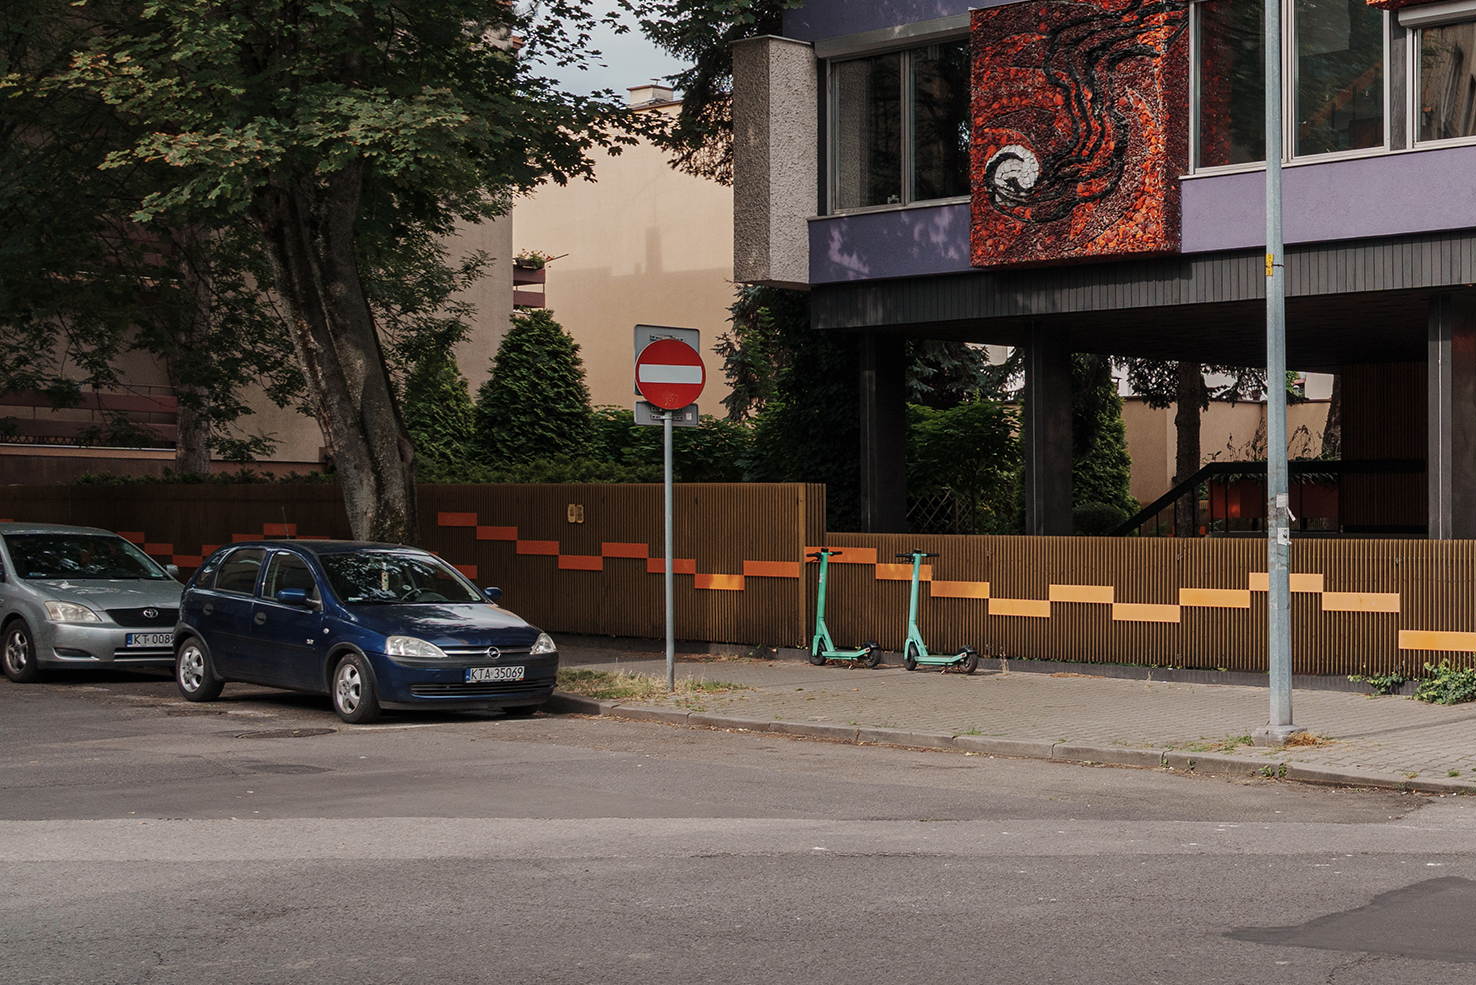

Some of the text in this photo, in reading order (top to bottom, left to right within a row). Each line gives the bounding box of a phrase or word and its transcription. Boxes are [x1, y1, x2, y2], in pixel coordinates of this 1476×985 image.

[133, 634, 149, 644] KT
[471, 667, 524, 680] KTA 35069
